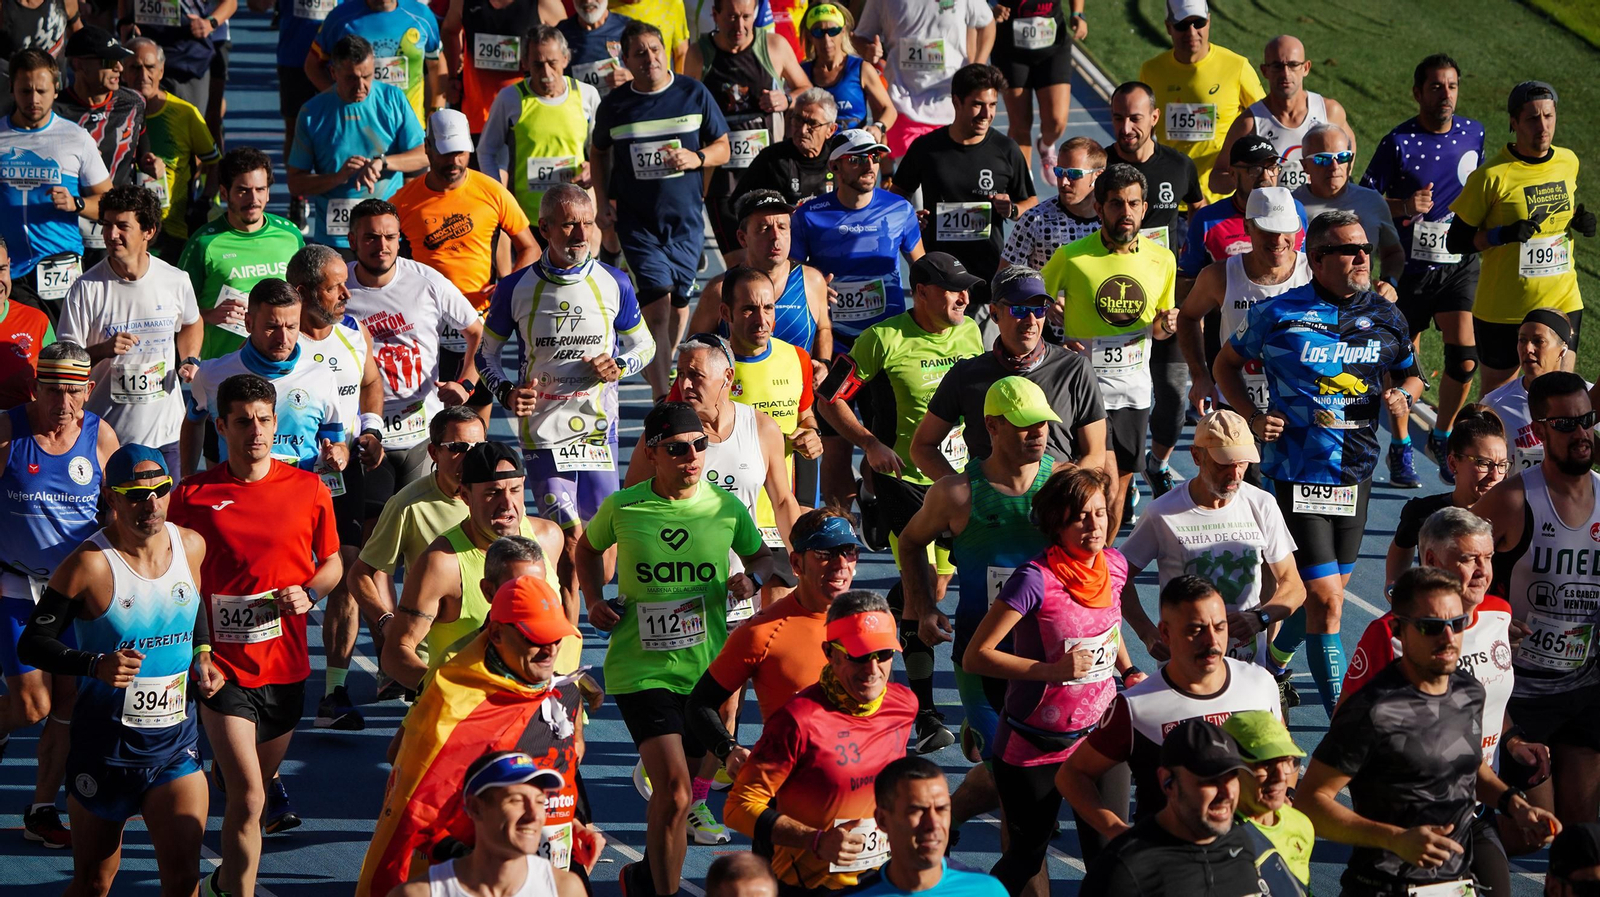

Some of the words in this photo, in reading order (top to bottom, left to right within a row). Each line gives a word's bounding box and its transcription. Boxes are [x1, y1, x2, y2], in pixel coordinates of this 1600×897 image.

[140, 0, 161, 13] 250
[1022, 25, 1036, 38] 60
[479, 43, 501, 58] 296
[908, 47, 923, 61] 21
[374, 66, 390, 80] 52
[584, 72, 599, 86] 40
[1171, 113, 1195, 128] 155
[637, 151, 662, 168] 378
[19, 167, 59, 180] VELETA
[538, 166, 554, 181] 67
[1280, 170, 1307, 186] 485
[809, 201, 831, 211] HOKA
[332, 208, 349, 223] 28
[943, 213, 970, 228] 210
[848, 225, 864, 234] edp
[1419, 232, 1445, 248] 531
[1527, 247, 1554, 264] 199
[229, 261, 288, 280] AIRBUS
[44, 271, 70, 287] 574
[836, 292, 865, 309] 382
[1099, 296, 1144, 312] Sherry
[368, 310, 388, 322] MEDIA
[441, 324, 465, 340] 44
[535, 333, 603, 349] VETE-RUNNERS
[1367, 339, 1381, 347] CLUB
[553, 348, 585, 360] JEREZ
[1103, 347, 1123, 363] 53
[118, 374, 148, 391] 113
[1247, 385, 1270, 403] 61
[1313, 396, 1332, 405] RINO
[752, 398, 798, 410] TRIATLÓN
[772, 410, 795, 418] REAL
[383, 414, 402, 433] 16
[559, 444, 587, 458] 447
[938, 439, 953, 456] 4
[1300, 484, 1333, 499] 649
[1201, 522, 1226, 531] MEDIA
[1178, 531, 1212, 545] BAHÍA
[1214, 533, 1229, 542] DE
[1231, 529, 1260, 542] CÁDIZ
[636, 560, 716, 584] sano
[1563, 599, 1598, 610] VENTURA
[219, 608, 254, 627] 342
[646, 613, 681, 634] 112
[1530, 628, 1567, 653] 465
[1091, 647, 1105, 666] 2
[133, 690, 168, 711] 394
[834, 742, 861, 767] 33
[861, 831, 877, 852] 3
